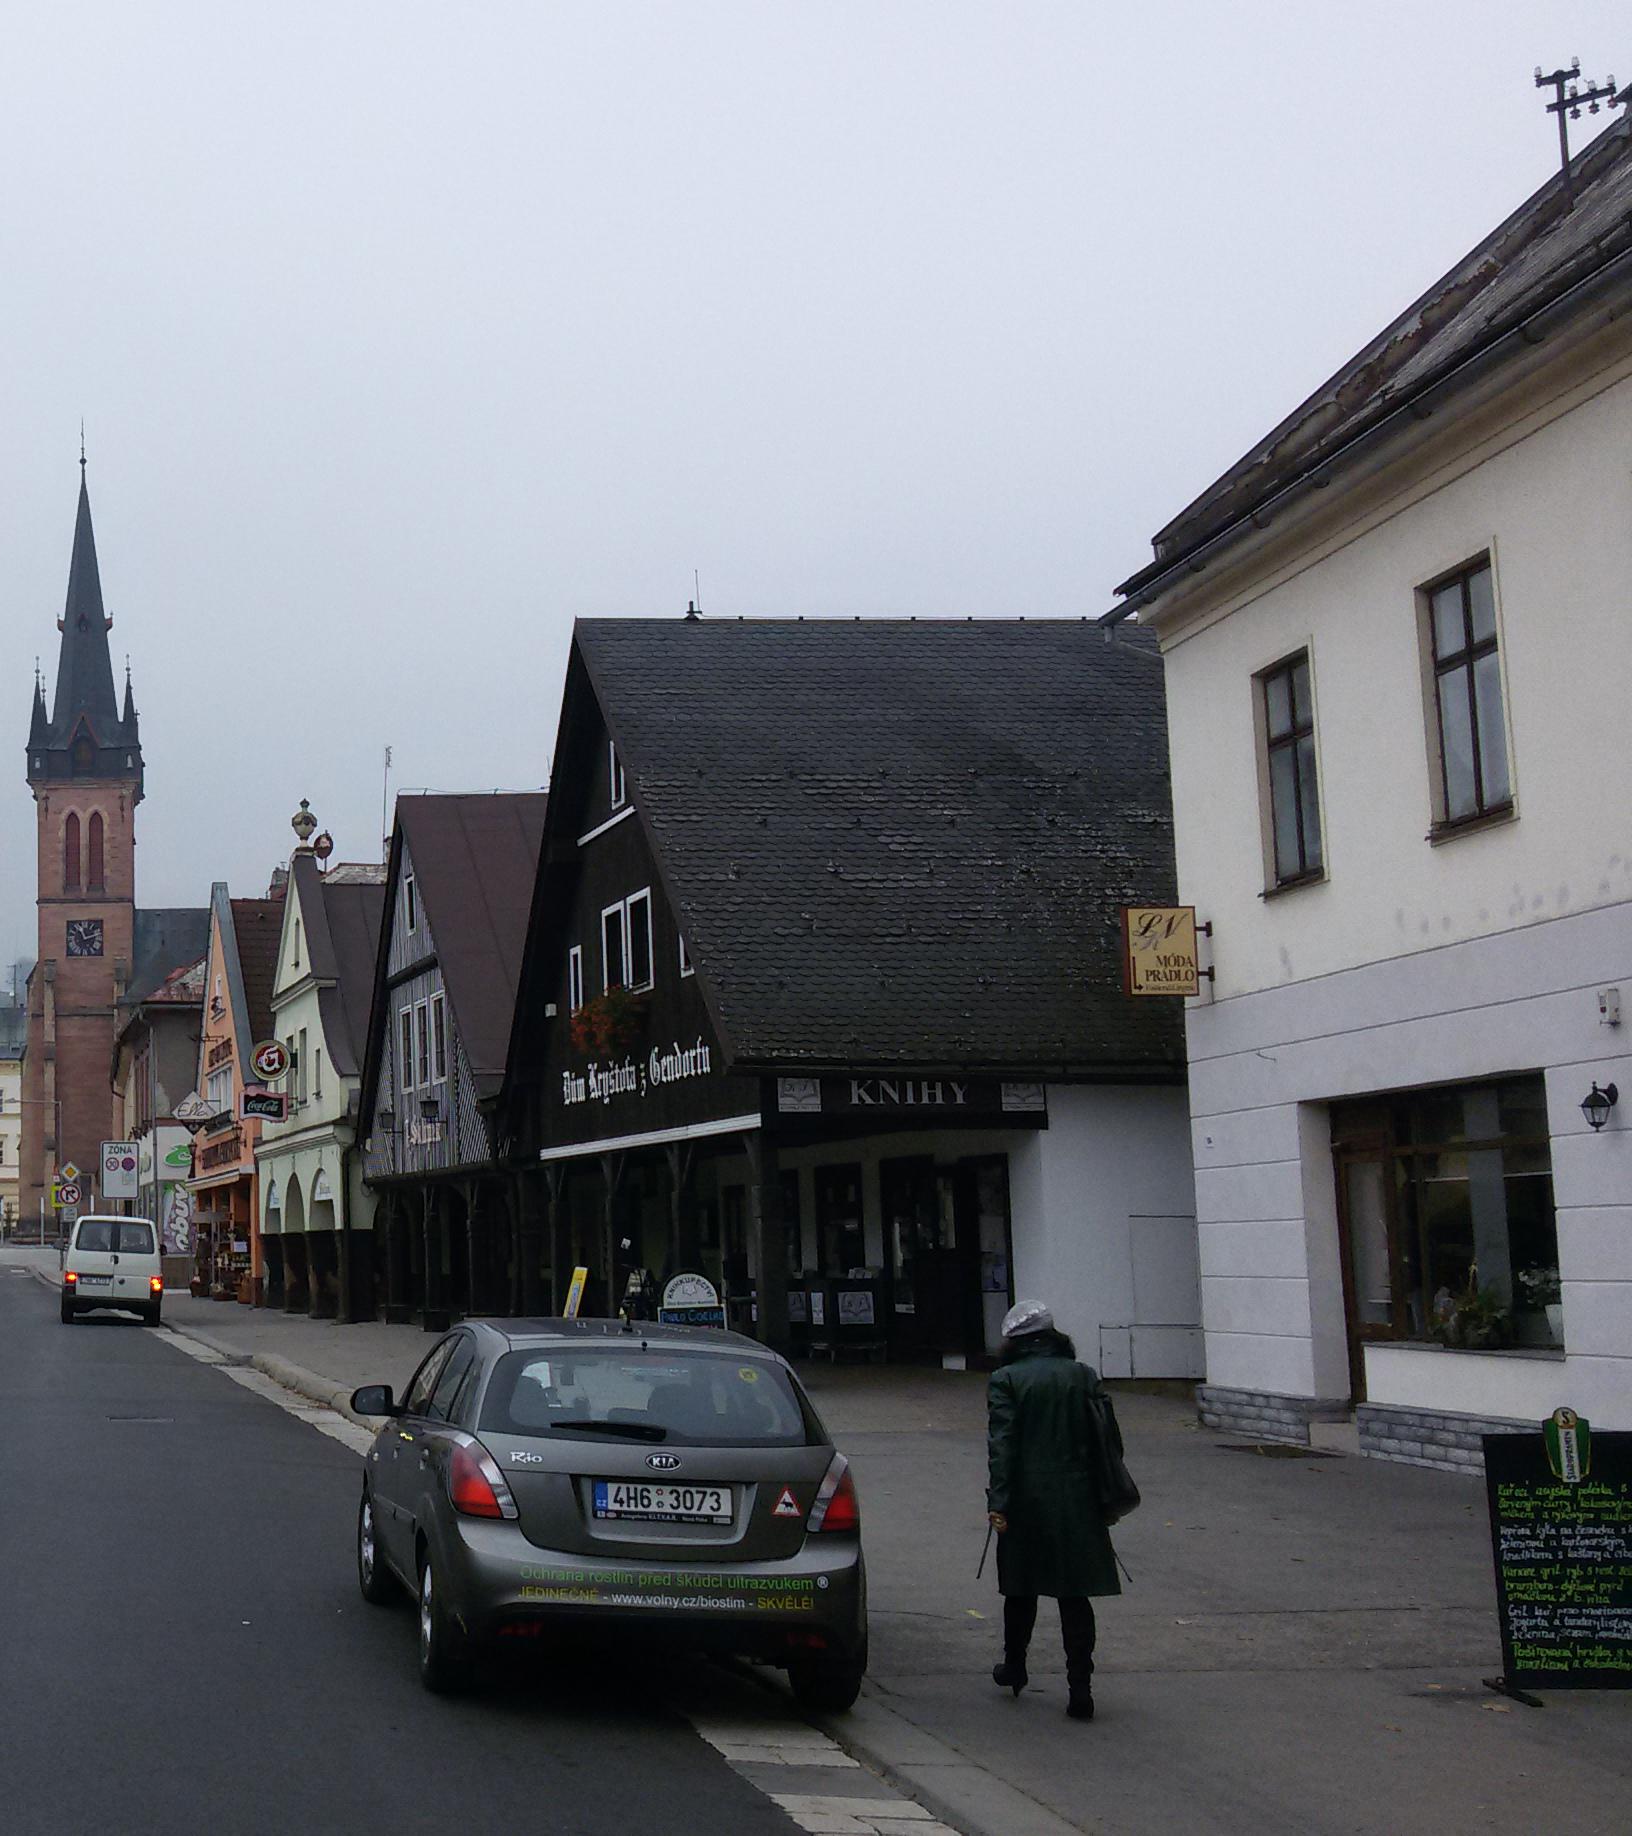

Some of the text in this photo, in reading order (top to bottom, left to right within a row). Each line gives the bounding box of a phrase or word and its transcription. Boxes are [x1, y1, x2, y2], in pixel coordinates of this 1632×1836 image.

[1156, 952, 1194, 968] MÓDA
[849, 1079, 969, 1105] KNIHY
[510, 1451, 544, 1464] Rio
[652, 1457, 676, 1468] KIA
[613, 1485, 722, 1513] 4H6 3073
[520, 1565, 584, 1583] Ochrana
[727, 1574, 814, 1592] ultrazvukem
[611, 1593, 746, 1610] www.volny.cz/biostim
